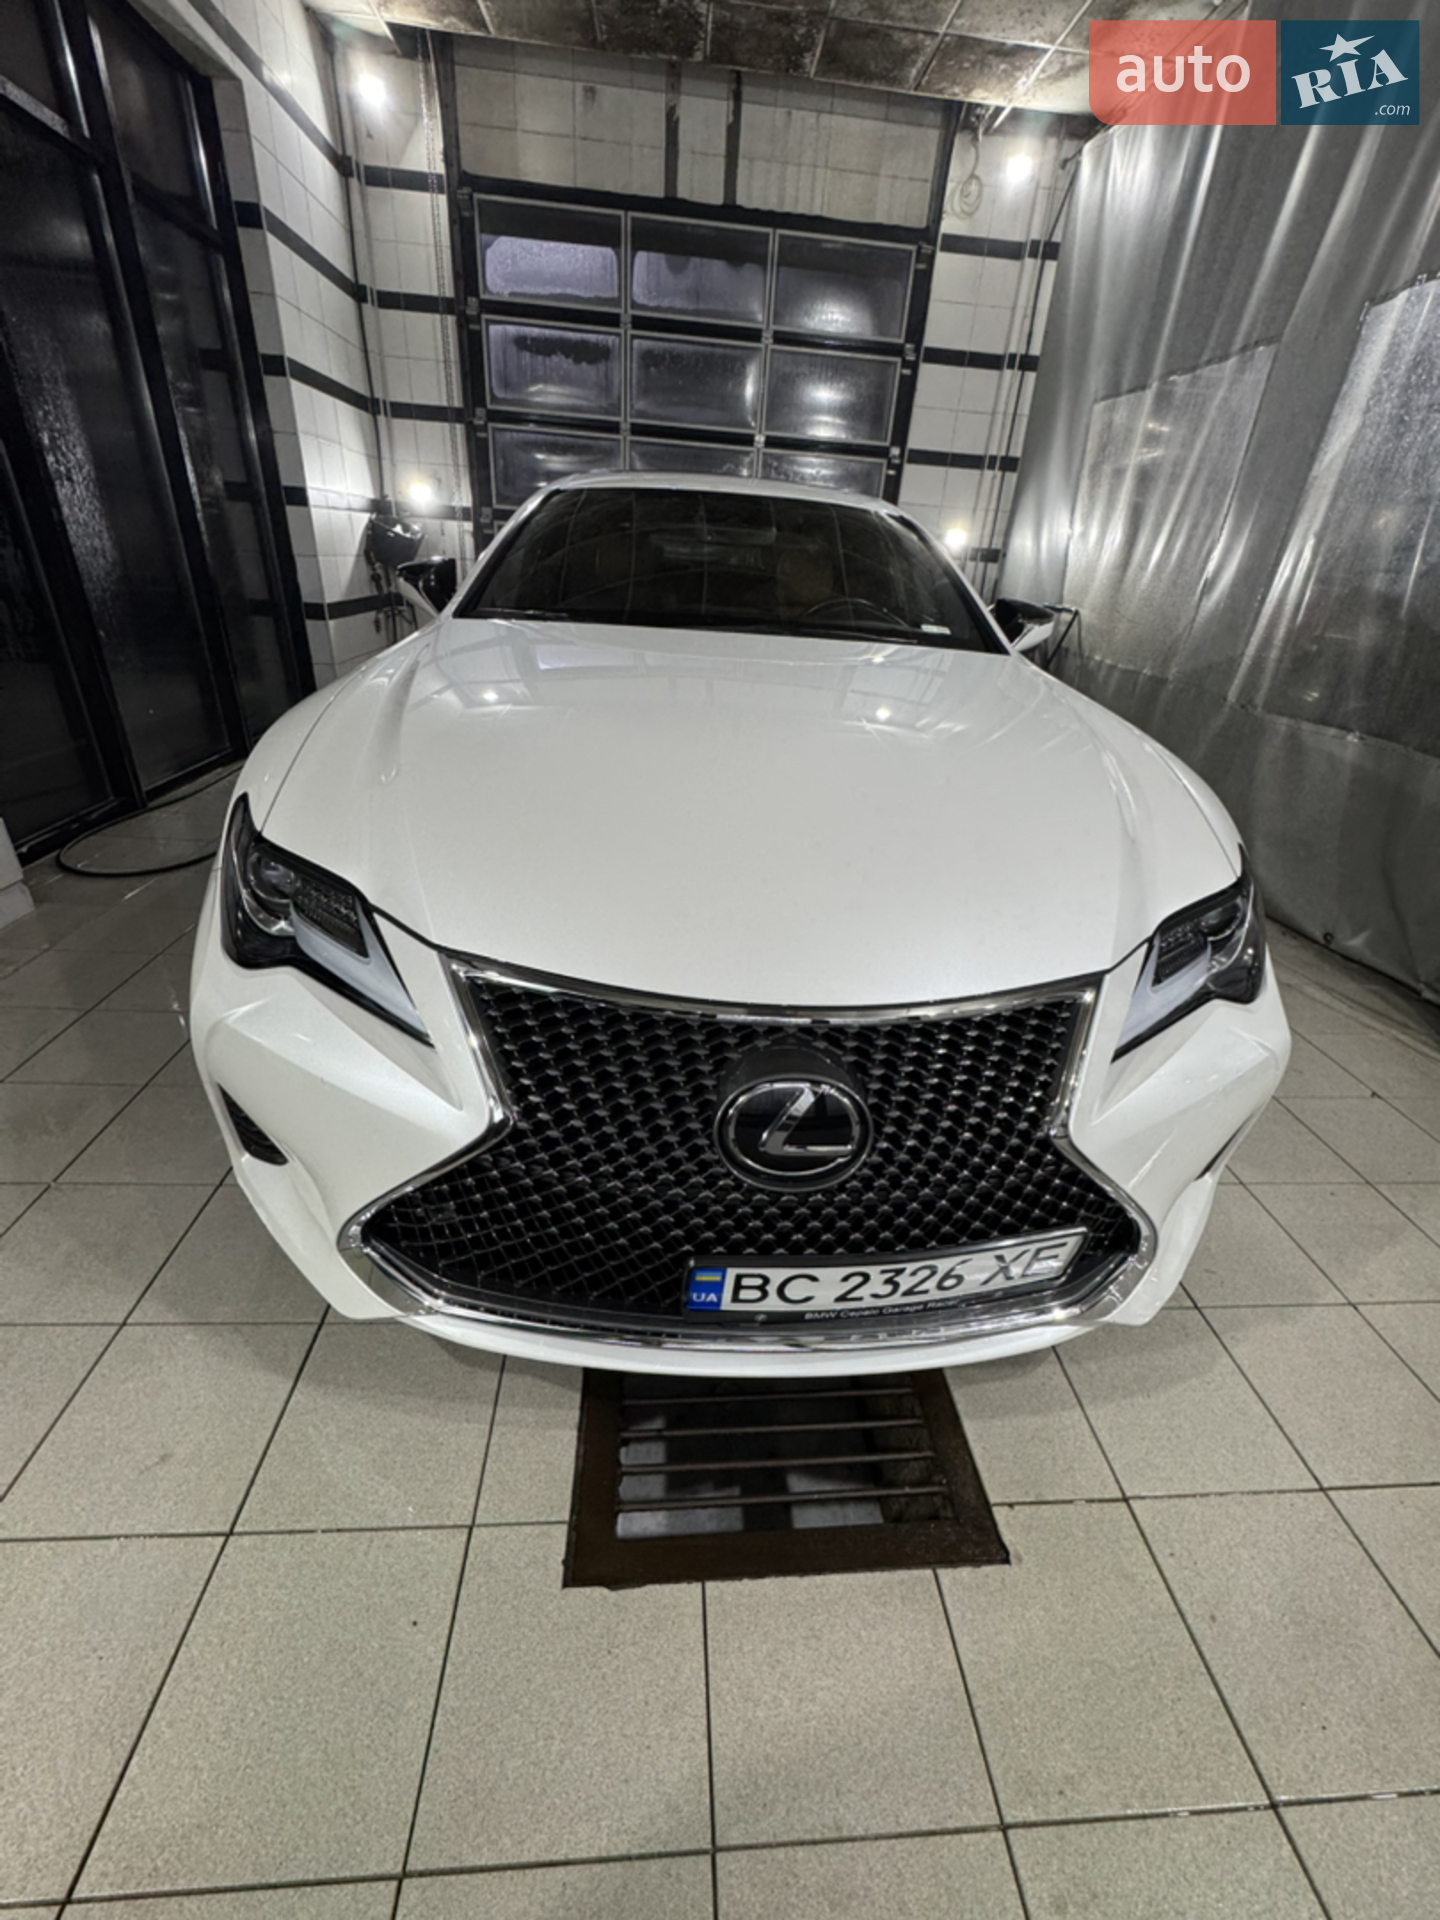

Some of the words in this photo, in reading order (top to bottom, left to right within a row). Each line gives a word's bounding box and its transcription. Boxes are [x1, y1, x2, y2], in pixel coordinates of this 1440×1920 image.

[730, 1272, 820, 1304] BC
[833, 1257, 974, 1303] 2326
[692, 1292, 718, 1303] UA
